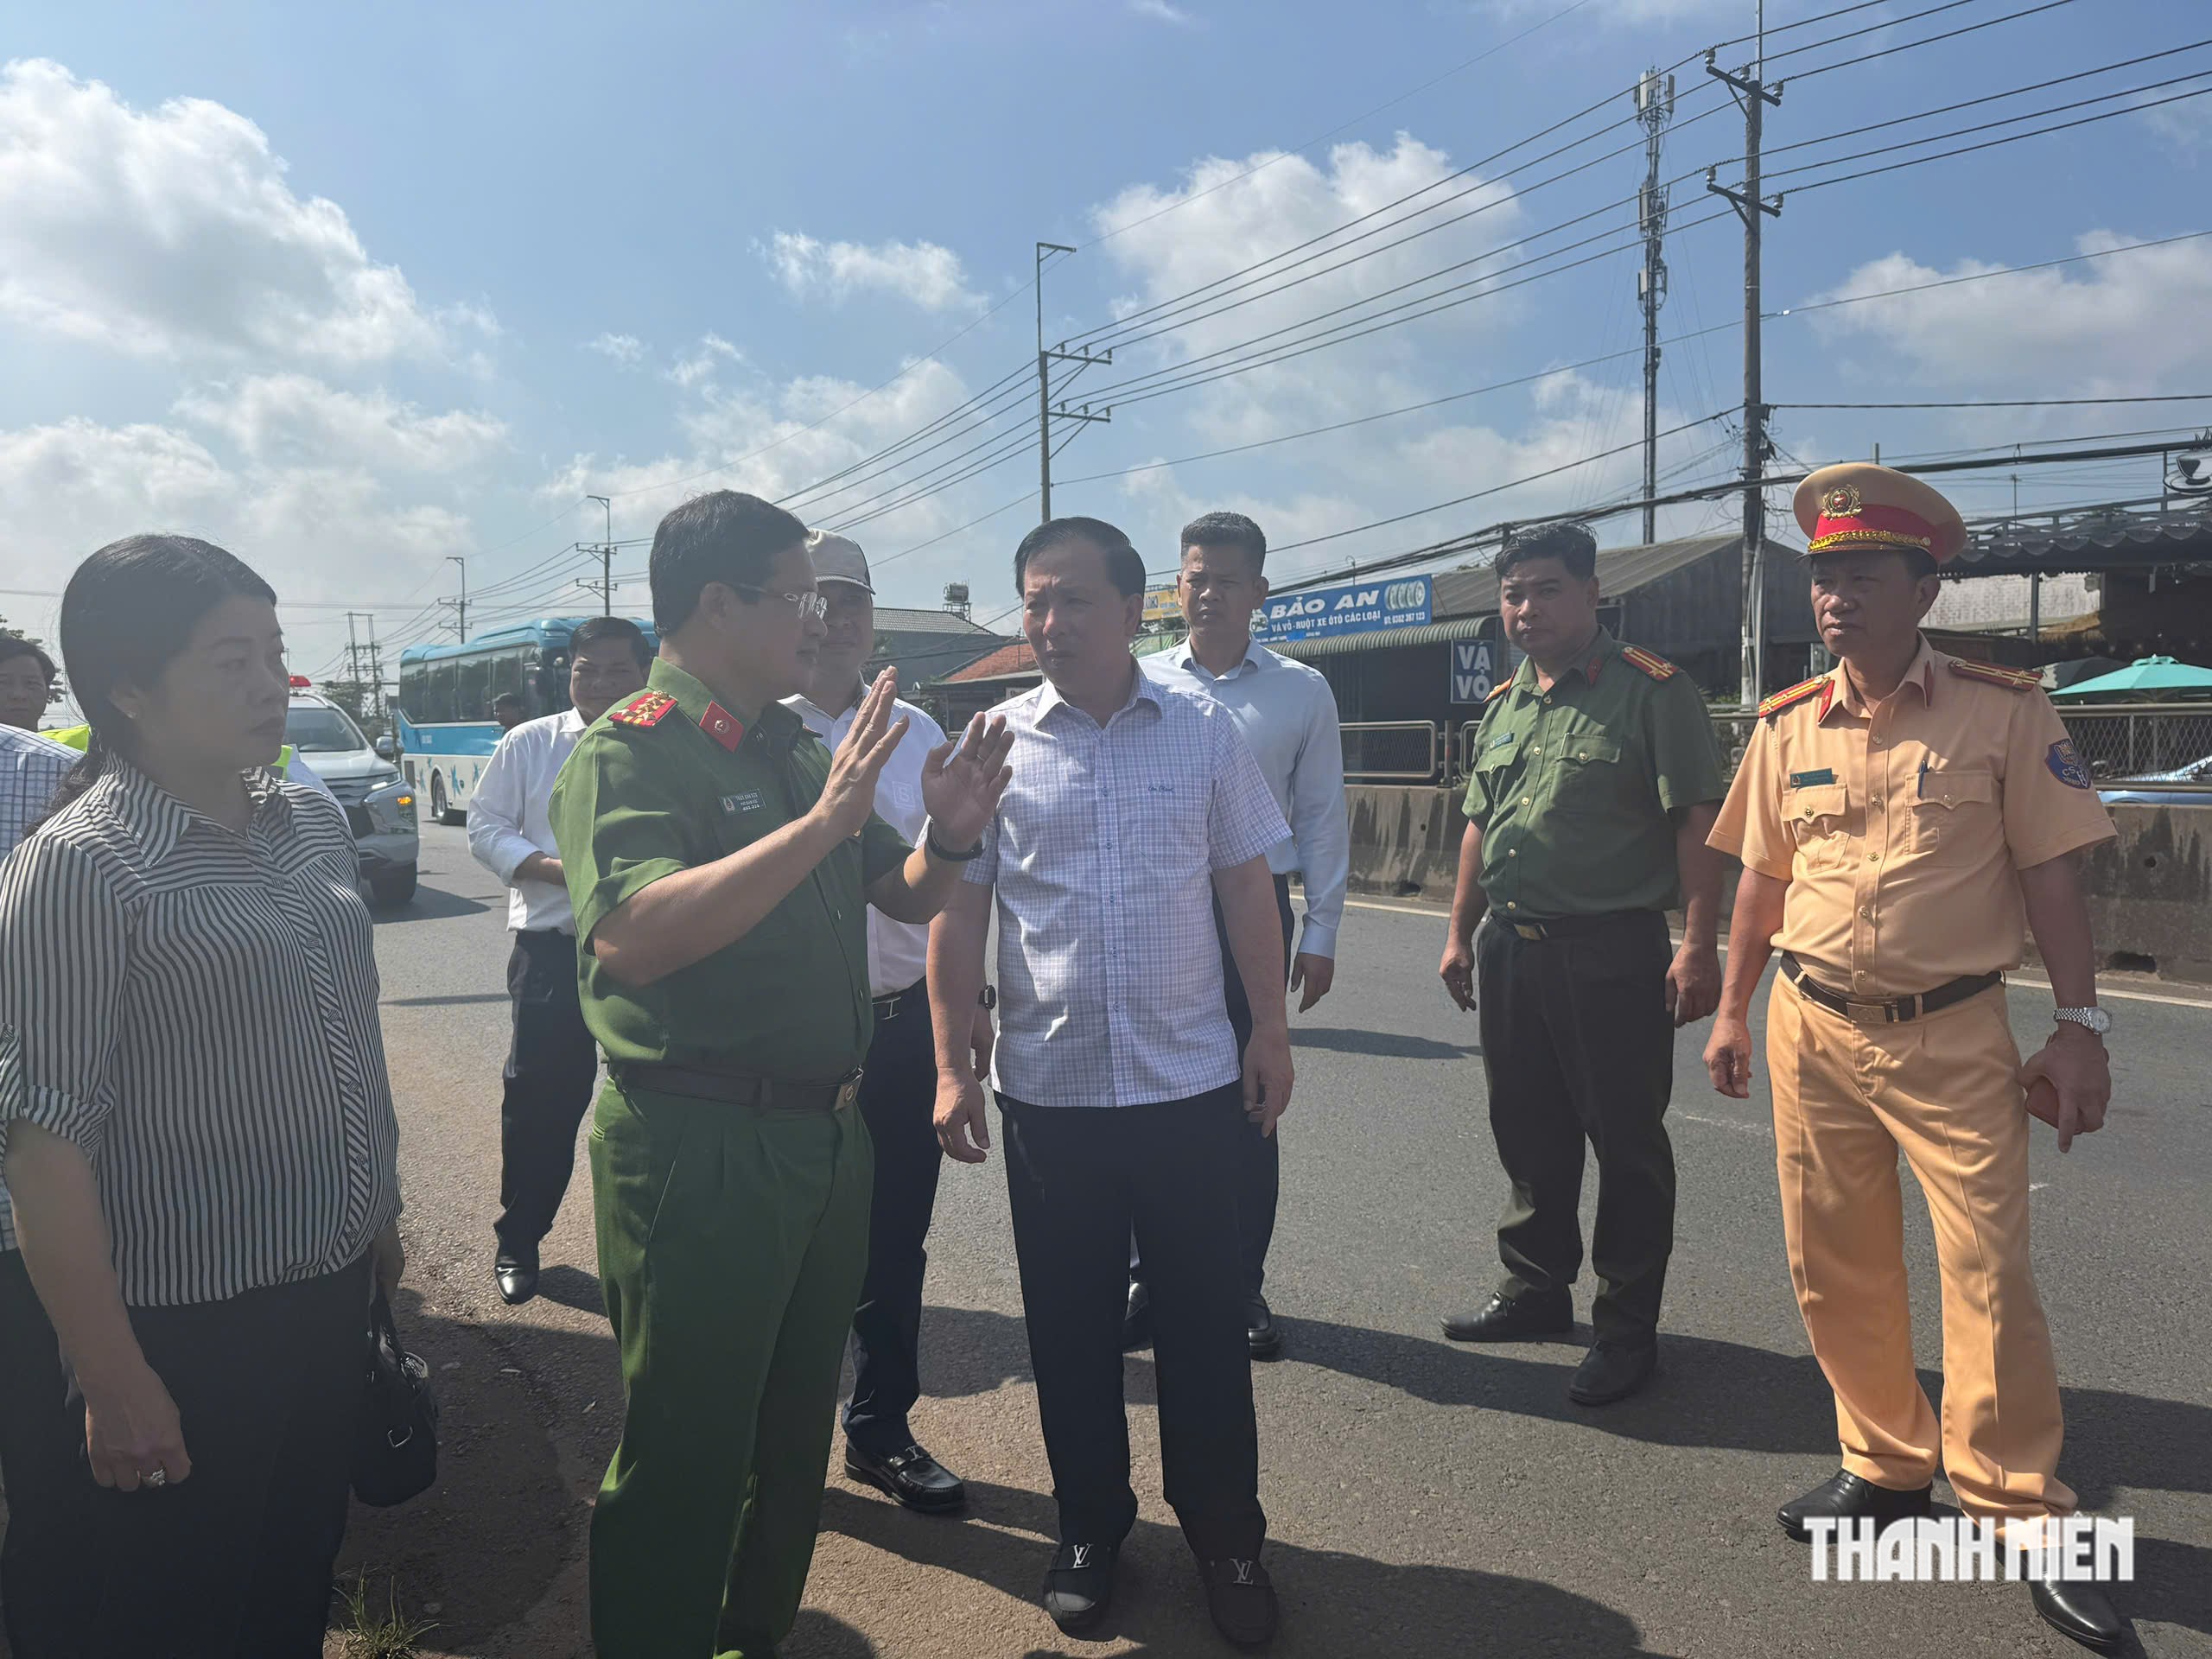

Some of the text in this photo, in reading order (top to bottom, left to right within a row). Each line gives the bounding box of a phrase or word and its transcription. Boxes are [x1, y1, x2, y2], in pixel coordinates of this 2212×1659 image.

[1270, 590, 1379, 619] BẢO AN
[1317, 618, 1327, 627] XE
[1344, 612, 1361, 622] CÁC
[1363, 610, 1381, 621] LOẠI
[1458, 641, 1491, 671] VÁ
[1456, 669, 1491, 700] VỎ
